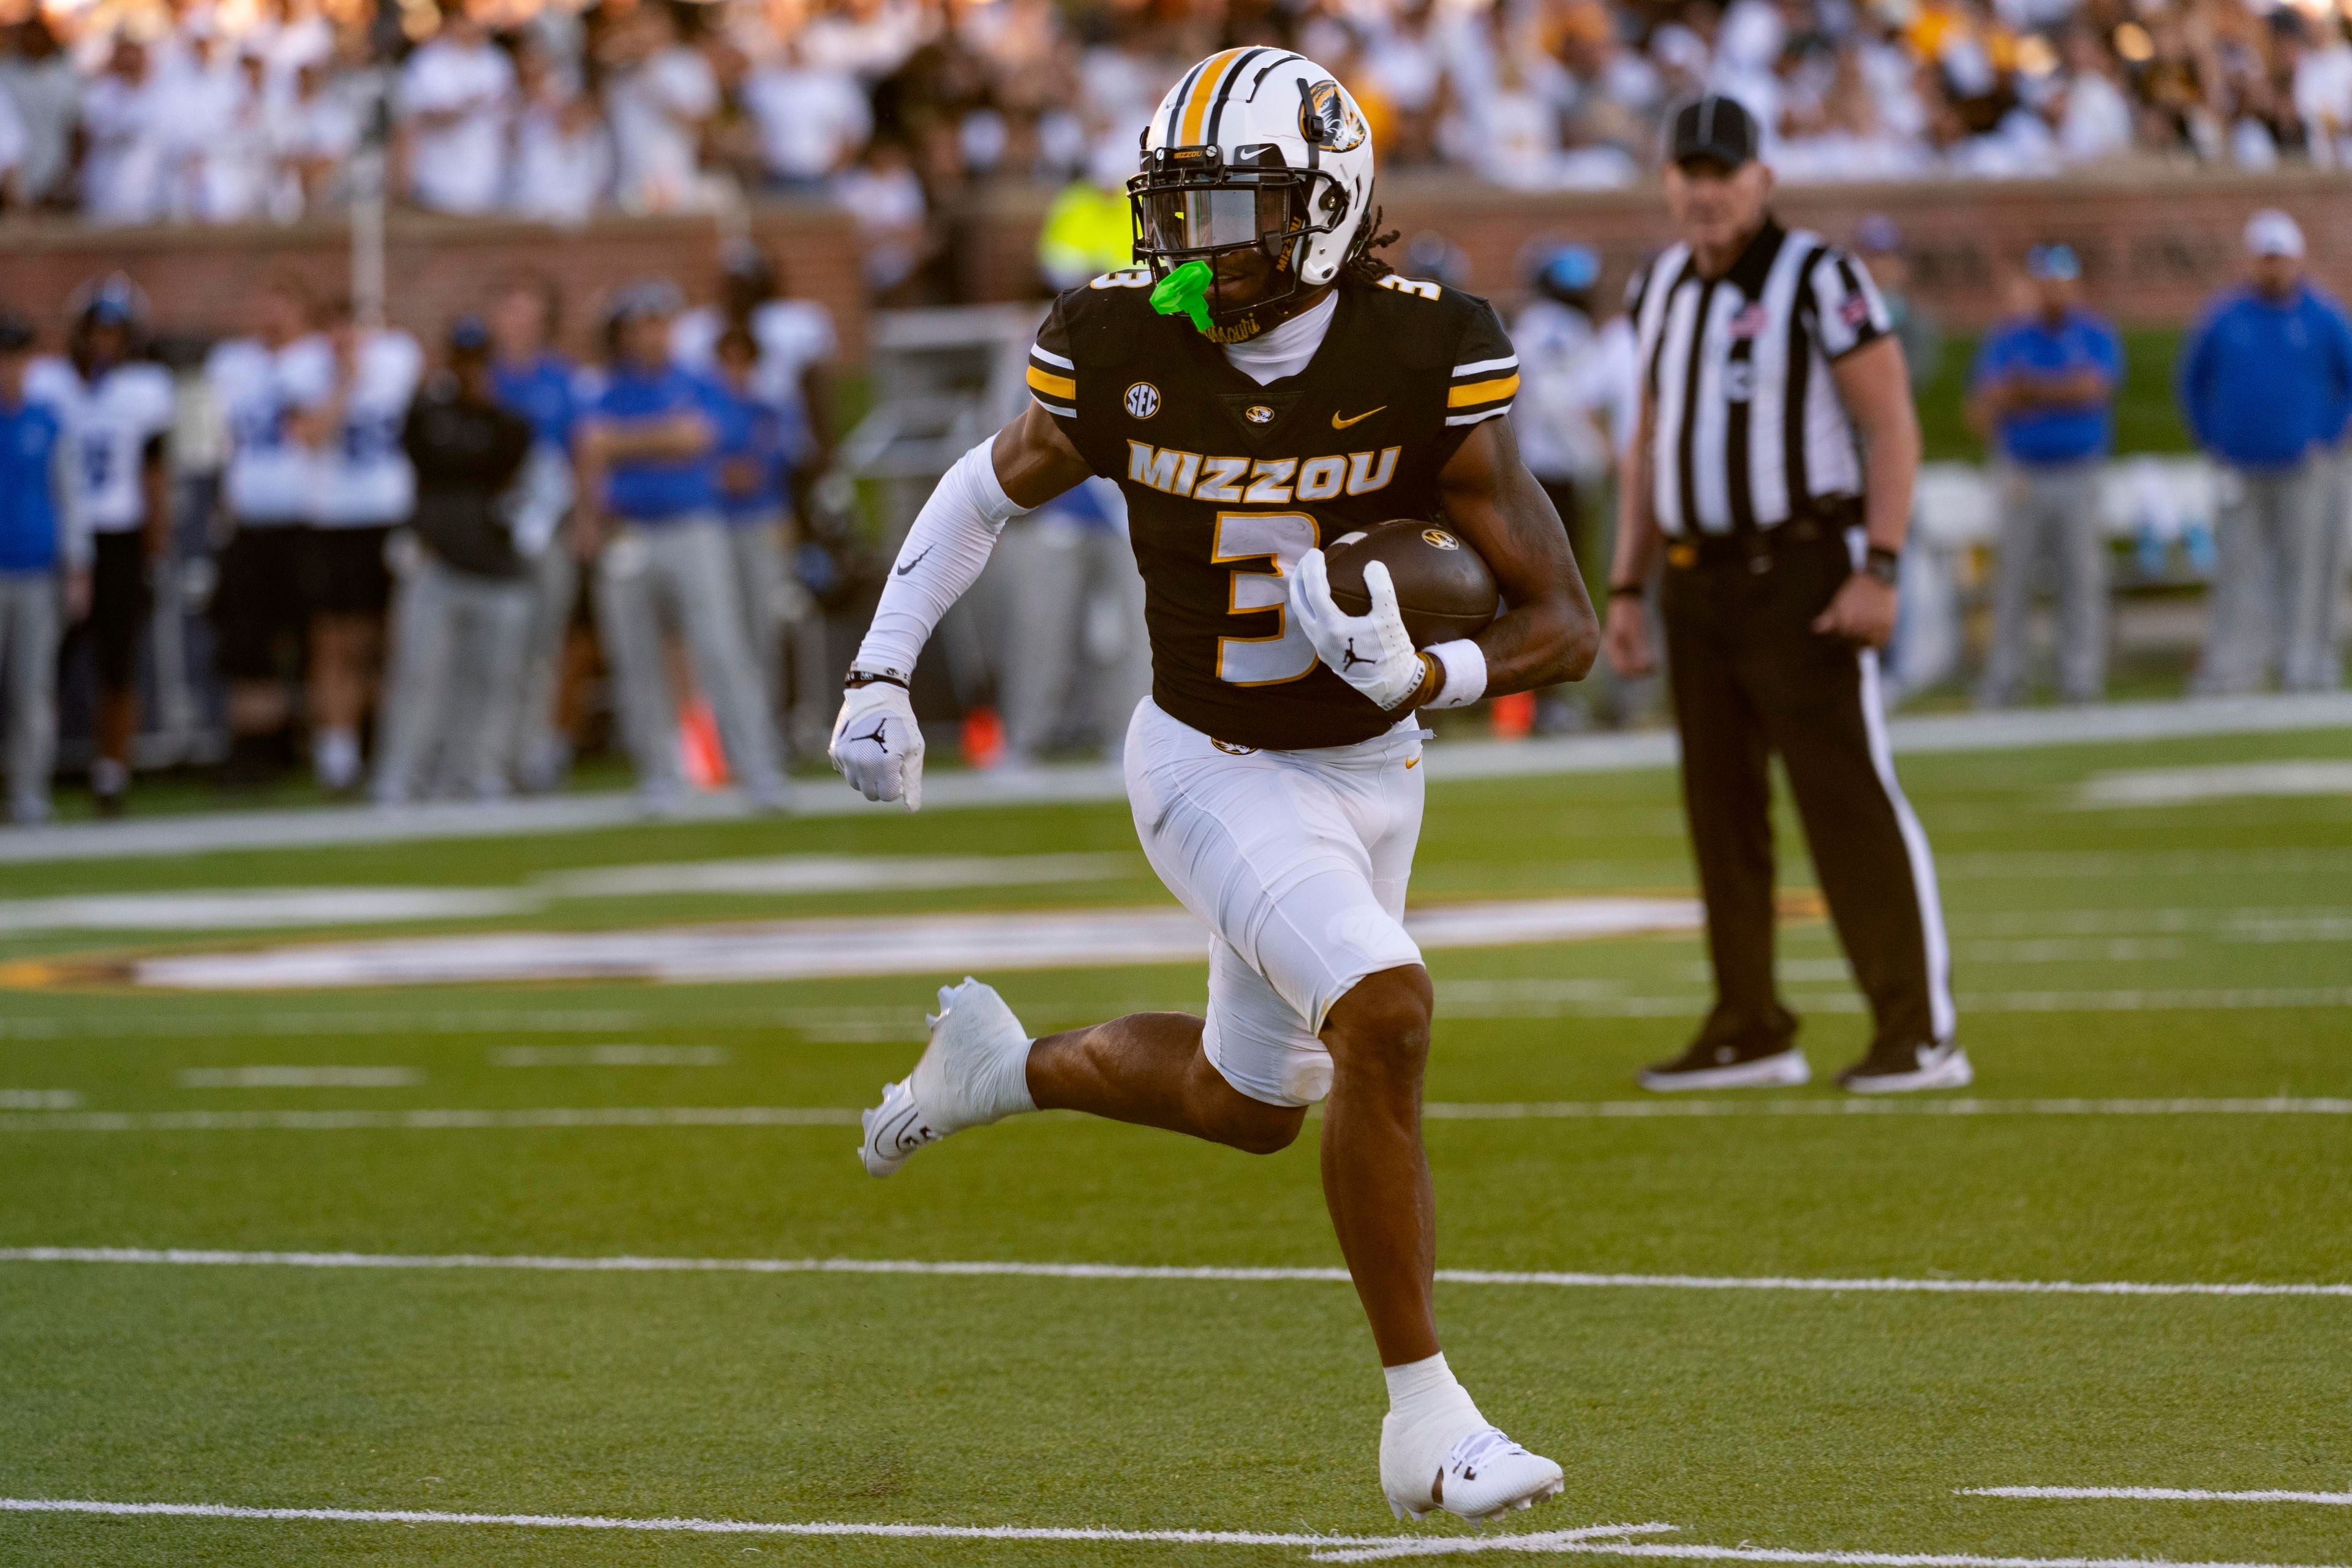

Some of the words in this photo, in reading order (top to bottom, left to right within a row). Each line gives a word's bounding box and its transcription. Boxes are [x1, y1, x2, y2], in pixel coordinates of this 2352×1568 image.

[1127, 384, 1158, 417] SEC
[1127, 439, 1402, 503] MIZZOU
[1211, 511, 1321, 687] 3
